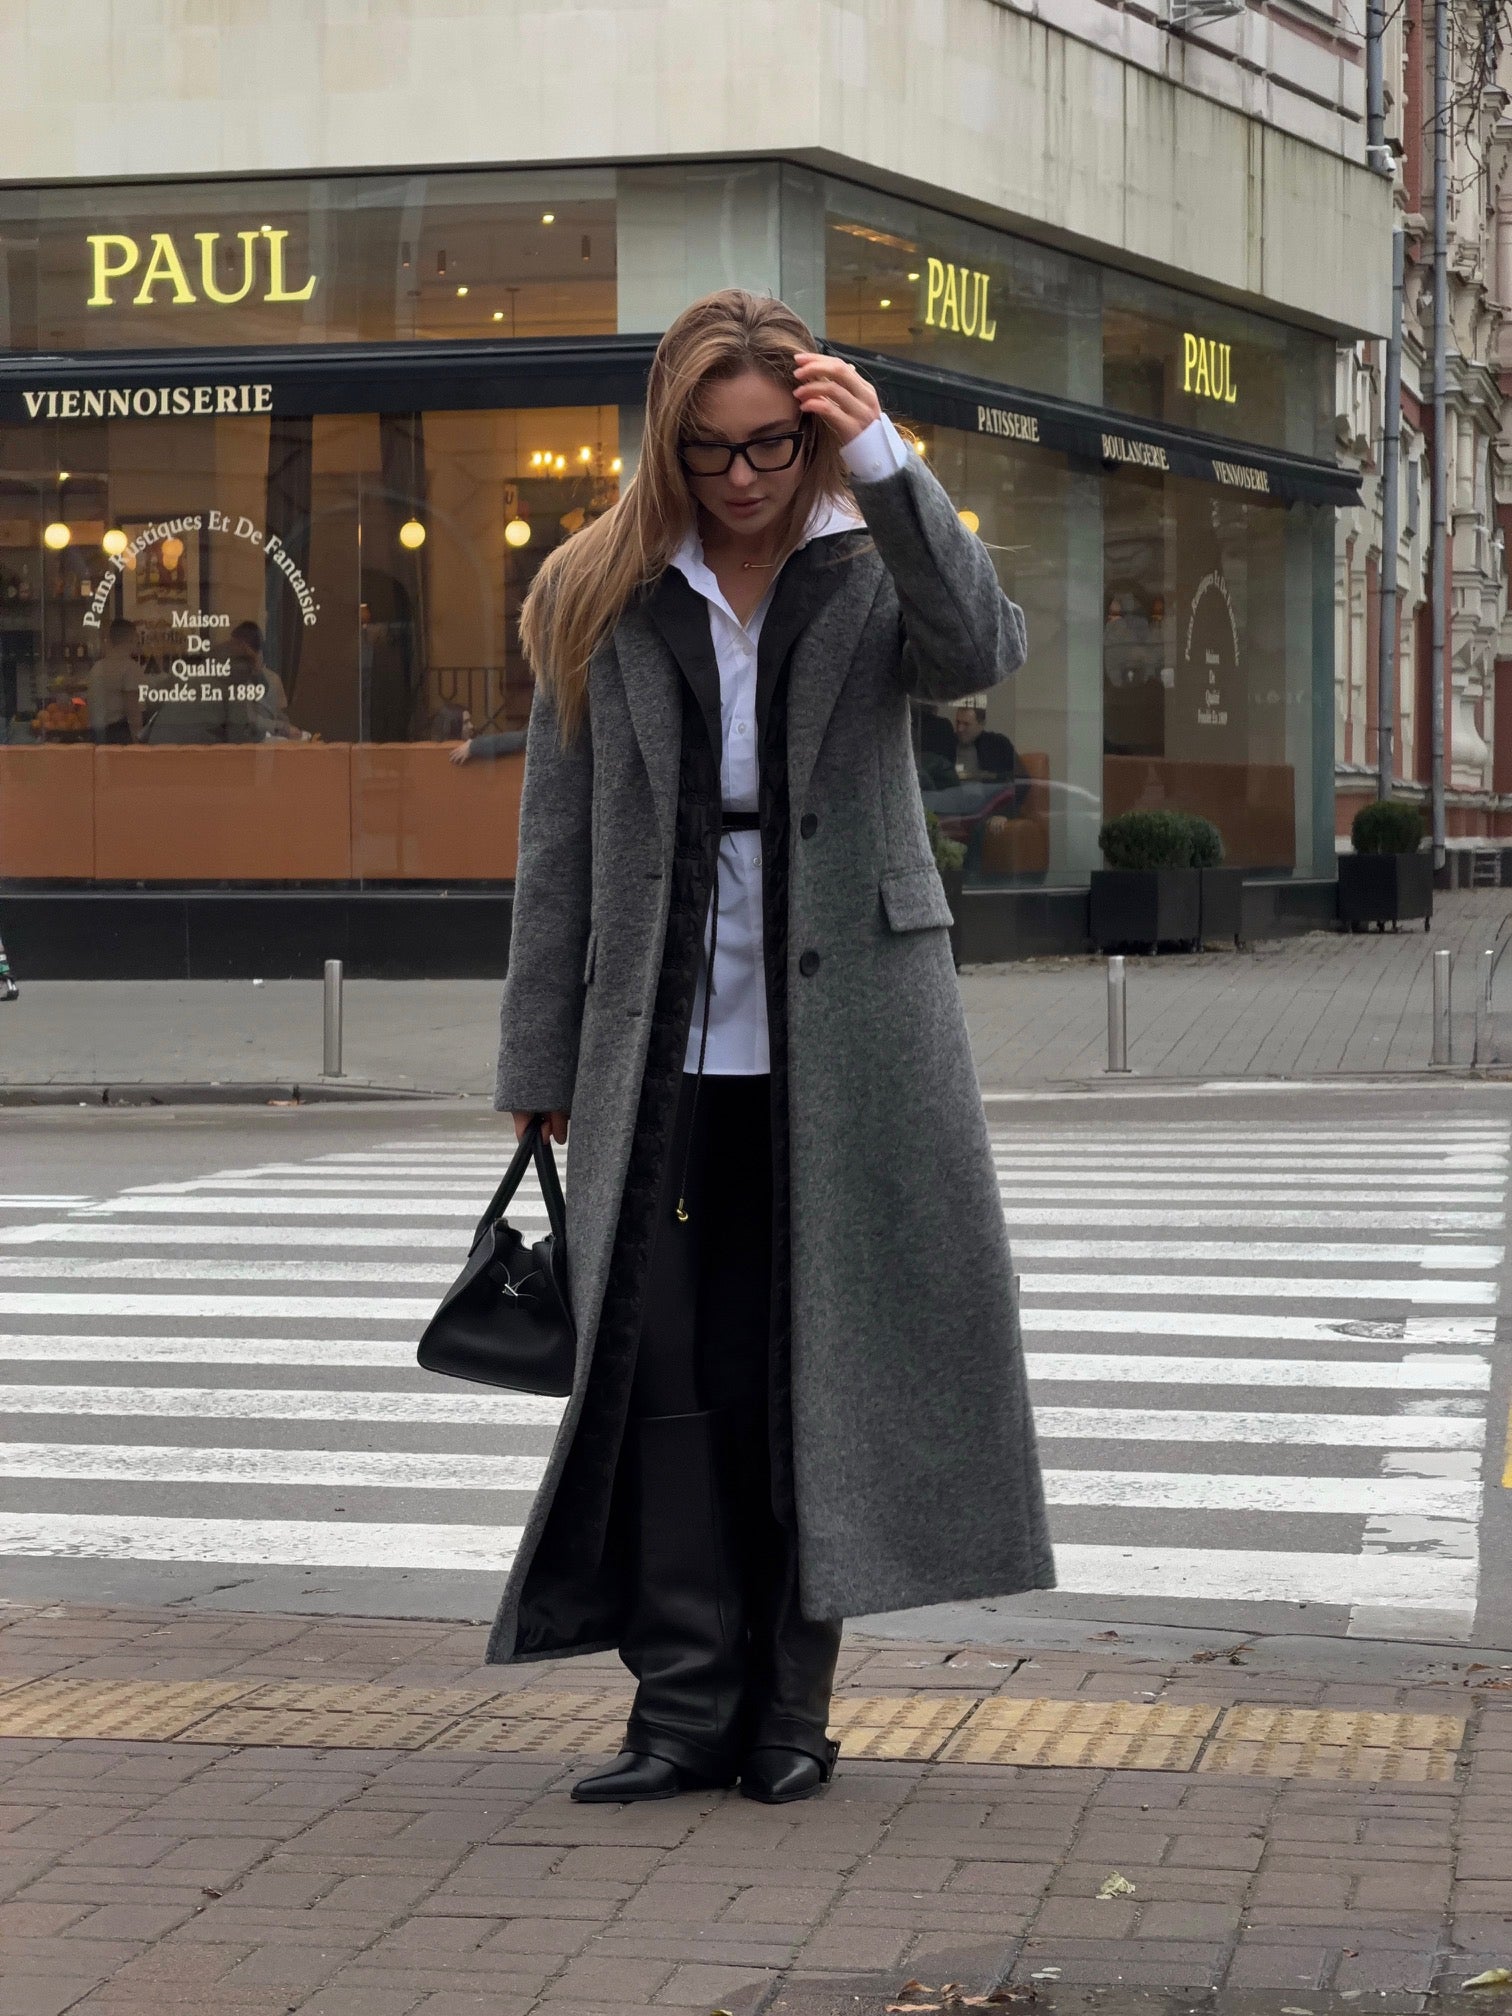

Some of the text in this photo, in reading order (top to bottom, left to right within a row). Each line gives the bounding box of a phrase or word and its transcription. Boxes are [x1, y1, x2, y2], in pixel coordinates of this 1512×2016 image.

[86, 230, 316, 305] PAUL
[925, 257, 996, 341] PAUL
[1183, 333, 1237, 403] PAUL
[23, 384, 273, 418] VIENNOISERIE
[977, 405, 1040, 442] PATISSERIE
[1101, 433, 1170, 470] BOULANGERIE
[1212, 460, 1270, 493] VIENNOISERIE
[83, 510, 321, 629] Pains Rustiques Et De Fantaisie
[171, 610, 230, 628] Maison
[187, 636, 211, 653] De
[171, 658, 231, 681] Qualité
[138, 684, 265, 702] Fondée En 1889
